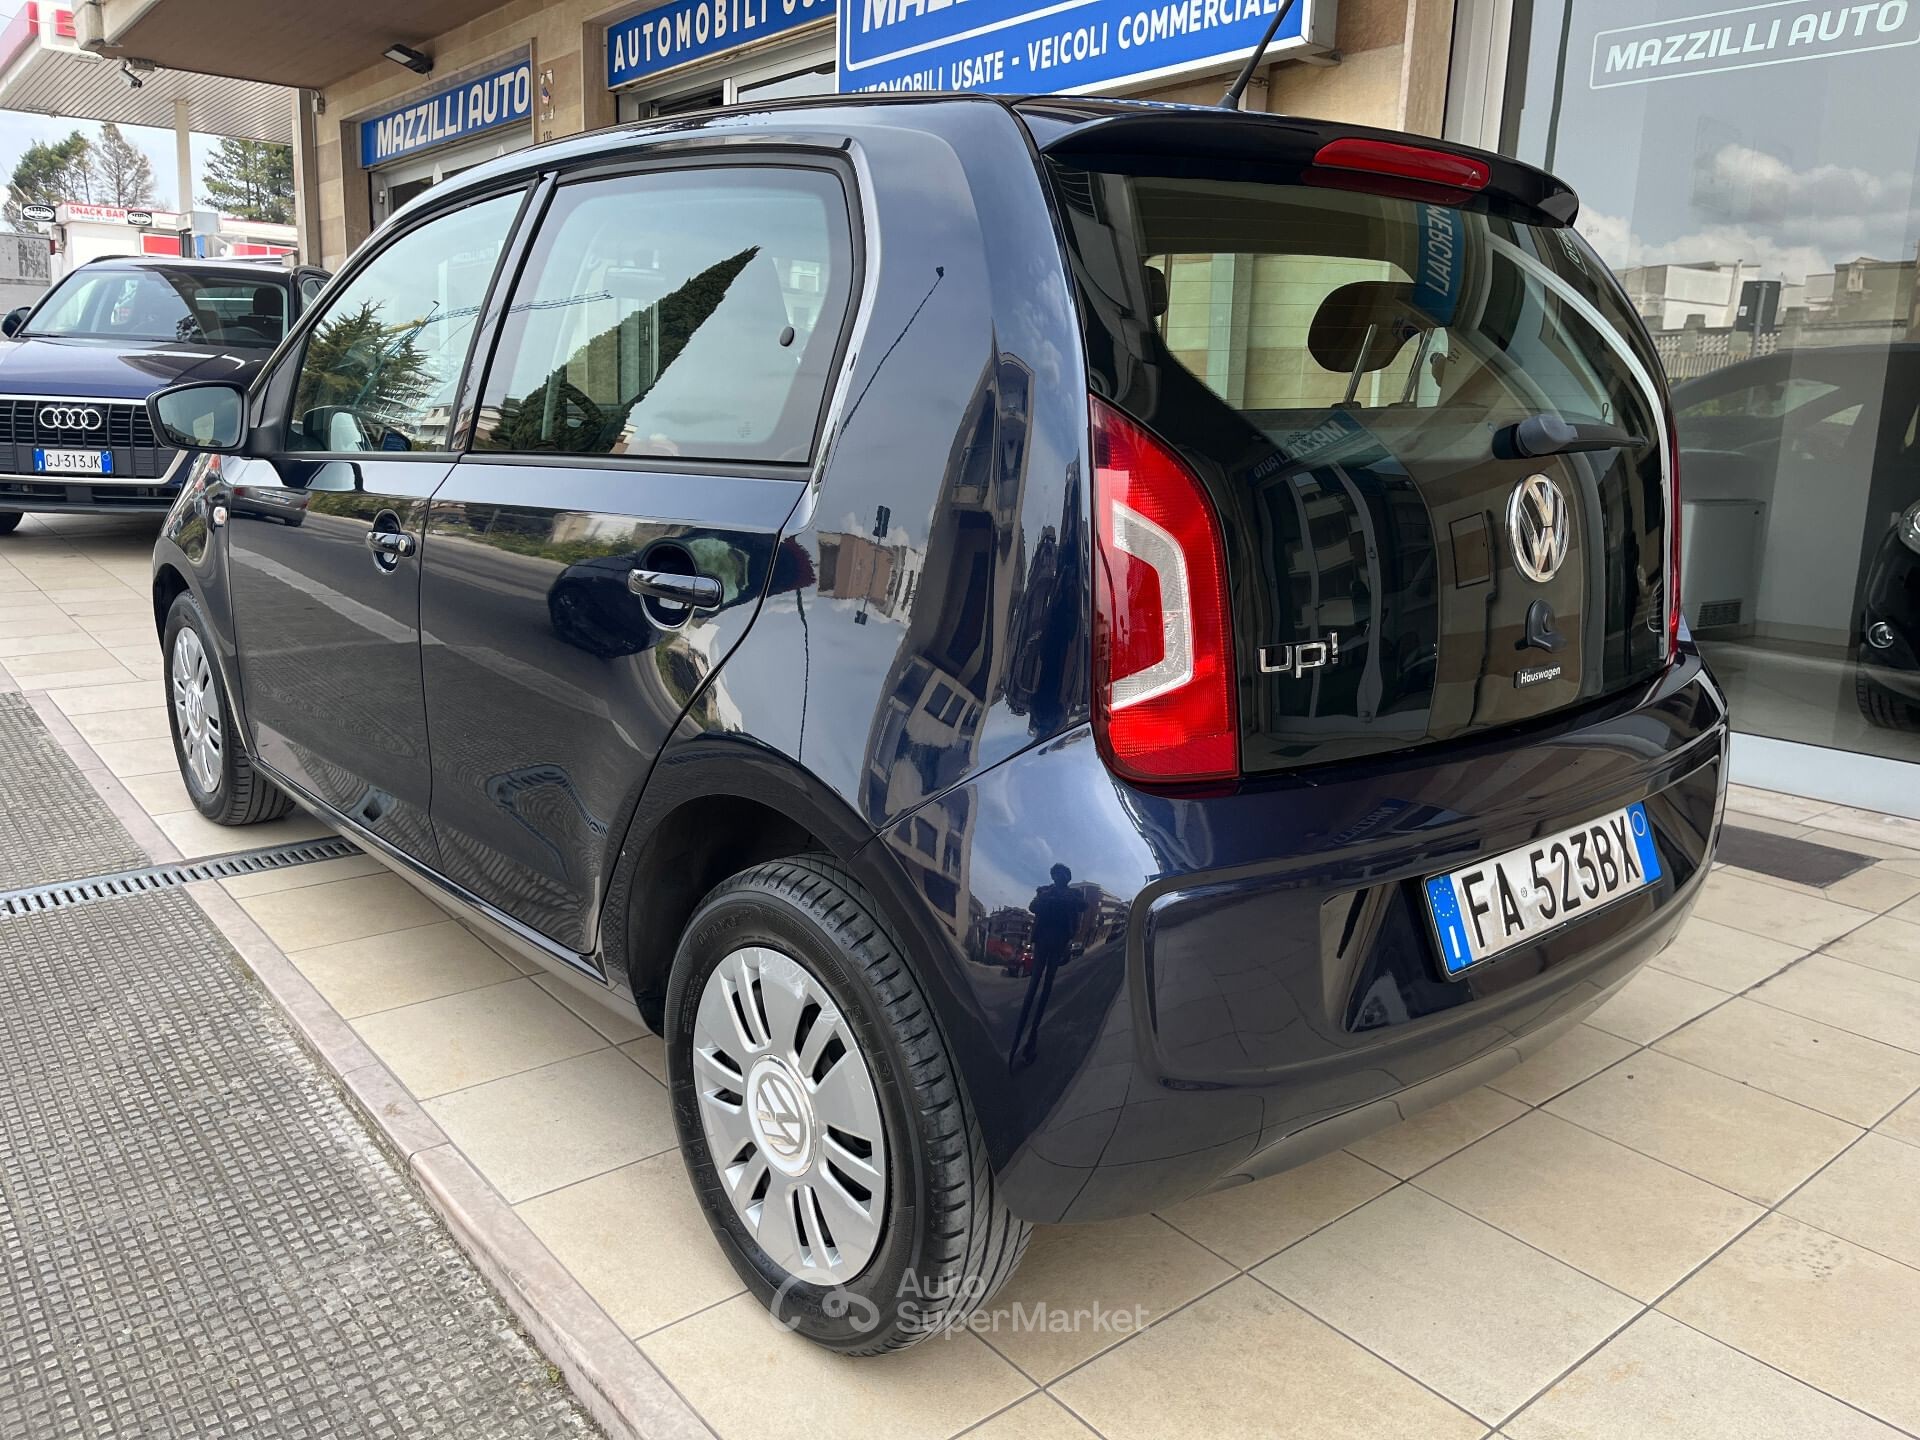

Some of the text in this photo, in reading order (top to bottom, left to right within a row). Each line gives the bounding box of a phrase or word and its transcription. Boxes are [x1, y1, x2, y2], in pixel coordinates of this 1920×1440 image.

[952, 50, 1004, 91] USATE
[1027, 22, 1108, 72] VEICOLI
[1605, 0, 1909, 73] MAZZILLI AUTO
[376, 66, 531, 159] MAZZILLI AUTO
[69, 205, 103, 217] SNACK
[106, 209, 126, 219] BAR
[1257, 630, 1339, 679] up!
[1520, 665, 1561, 684] Hauswagen
